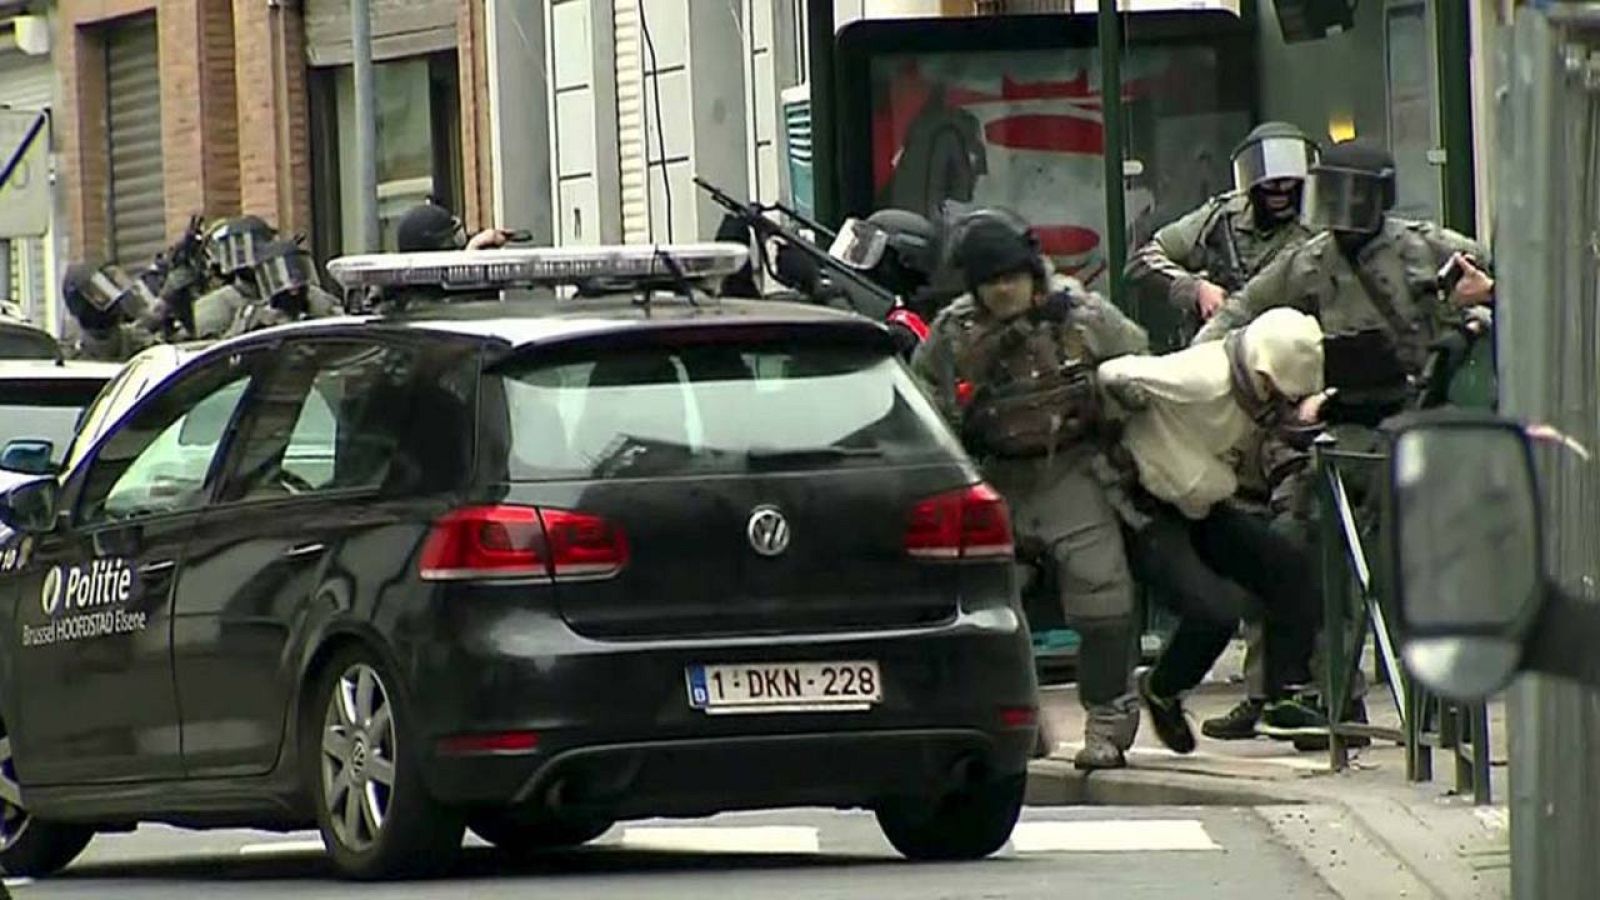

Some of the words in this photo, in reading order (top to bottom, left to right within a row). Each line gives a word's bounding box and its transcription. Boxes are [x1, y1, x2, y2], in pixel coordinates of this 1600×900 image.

[65, 557, 131, 609] Politie
[22, 619, 56, 646] Brussel
[56, 611, 114, 642] HOOFDSTAD
